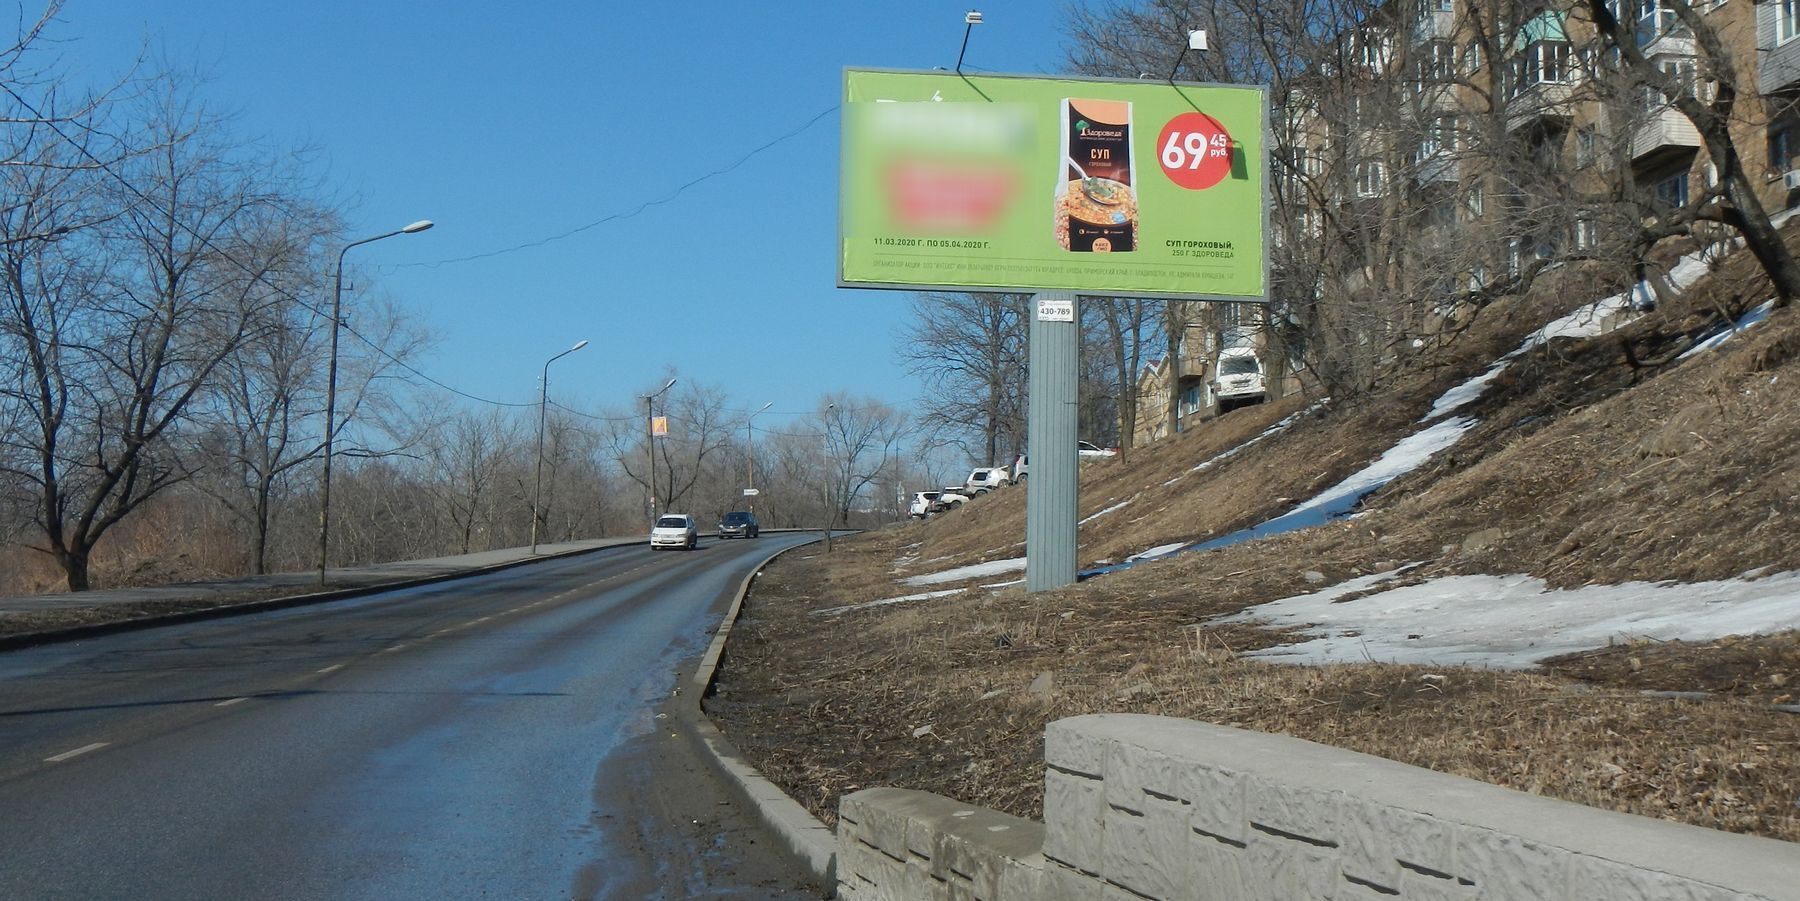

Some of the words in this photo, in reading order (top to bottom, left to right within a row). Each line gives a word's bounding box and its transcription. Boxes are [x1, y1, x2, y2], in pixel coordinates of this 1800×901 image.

[1090, 148, 1110, 159] СУП
[1162, 131, 1208, 170] 69
[1210, 133, 1227, 147] 45
[1210, 148, 1229, 157] руб.
[874, 238, 916, 247] 11.03.2020
[917, 239, 925, 247] Г.
[927, 239, 938, 247] ПО
[940, 240, 982, 249] 05.04.2020
[983, 241, 991, 249] Г.
[1184, 241, 1235, 250] ГОРОХОВЫЙ,
[1192, 250, 1234, 258] ЗДОРОВЕДА
[1040, 307, 1071, 315] 430-789
